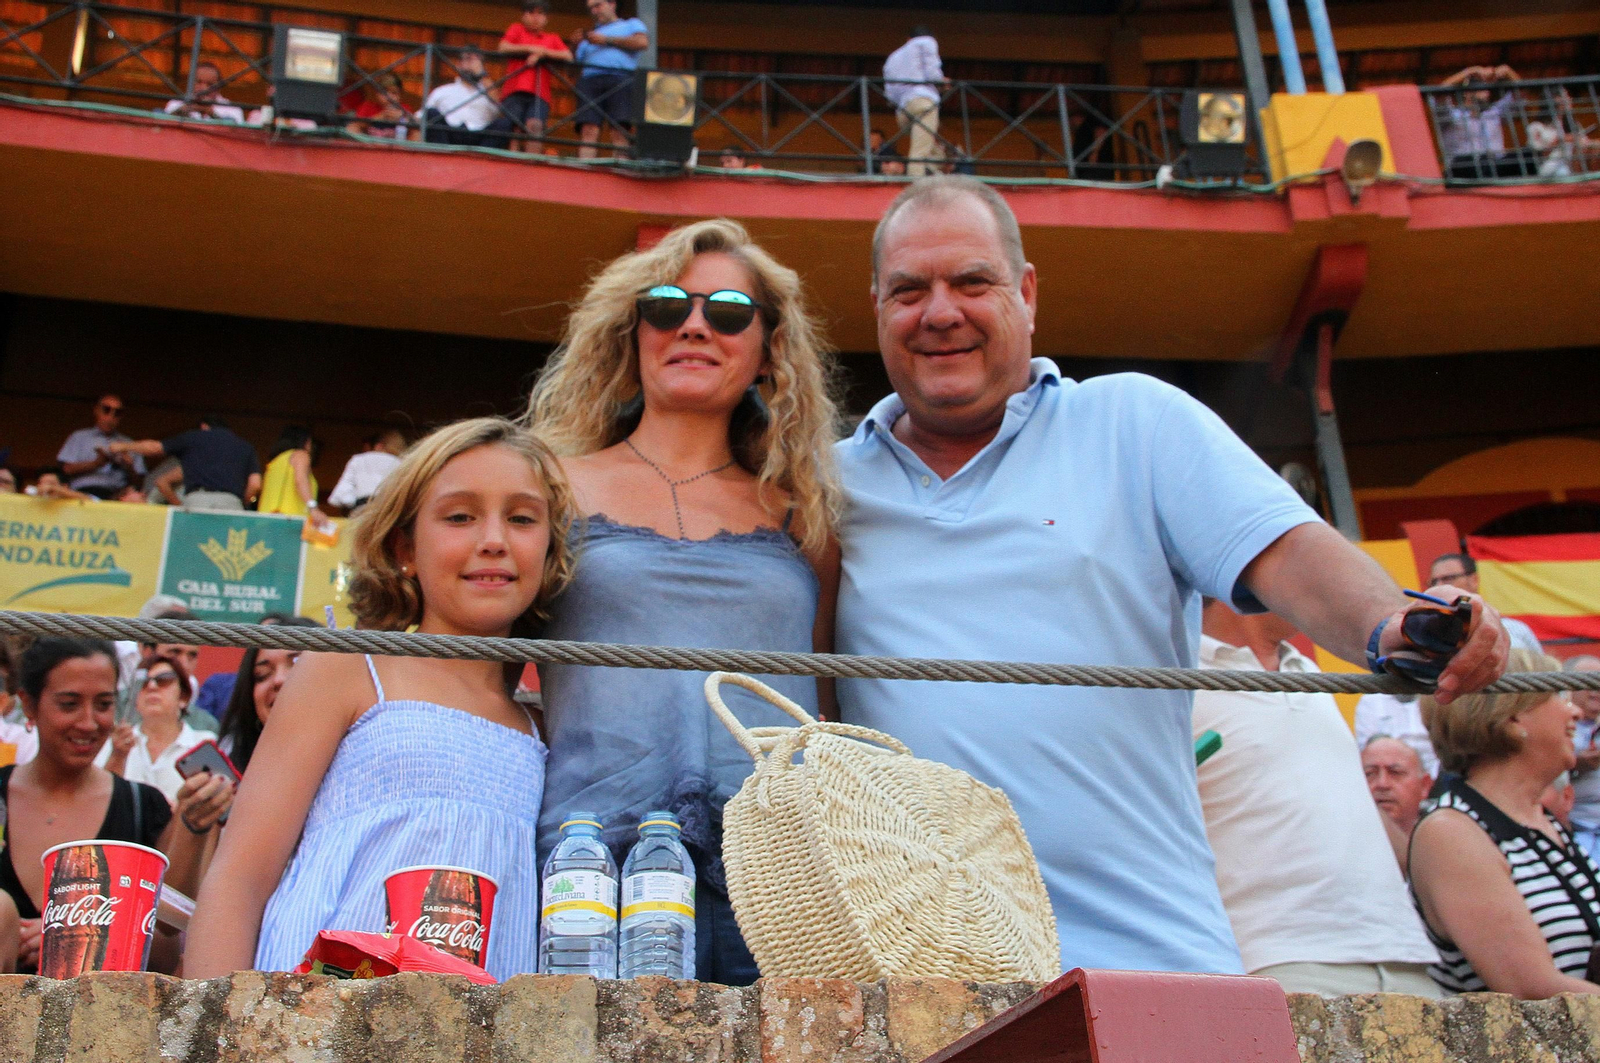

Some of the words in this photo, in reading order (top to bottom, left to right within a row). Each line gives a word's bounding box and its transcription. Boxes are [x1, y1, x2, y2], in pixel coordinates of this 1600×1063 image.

[0, 545, 116, 569] NDALUZA
[177, 579, 219, 596] CAJA
[223, 584, 281, 600] RURAL
[190, 596, 225, 611] DEL
[229, 598, 266, 614] SUR
[53, 884, 77, 895] SABOR
[77, 883, 102, 891] LIGHT
[423, 905, 450, 913] SABOR
[451, 907, 481, 920] ORIGINAL
